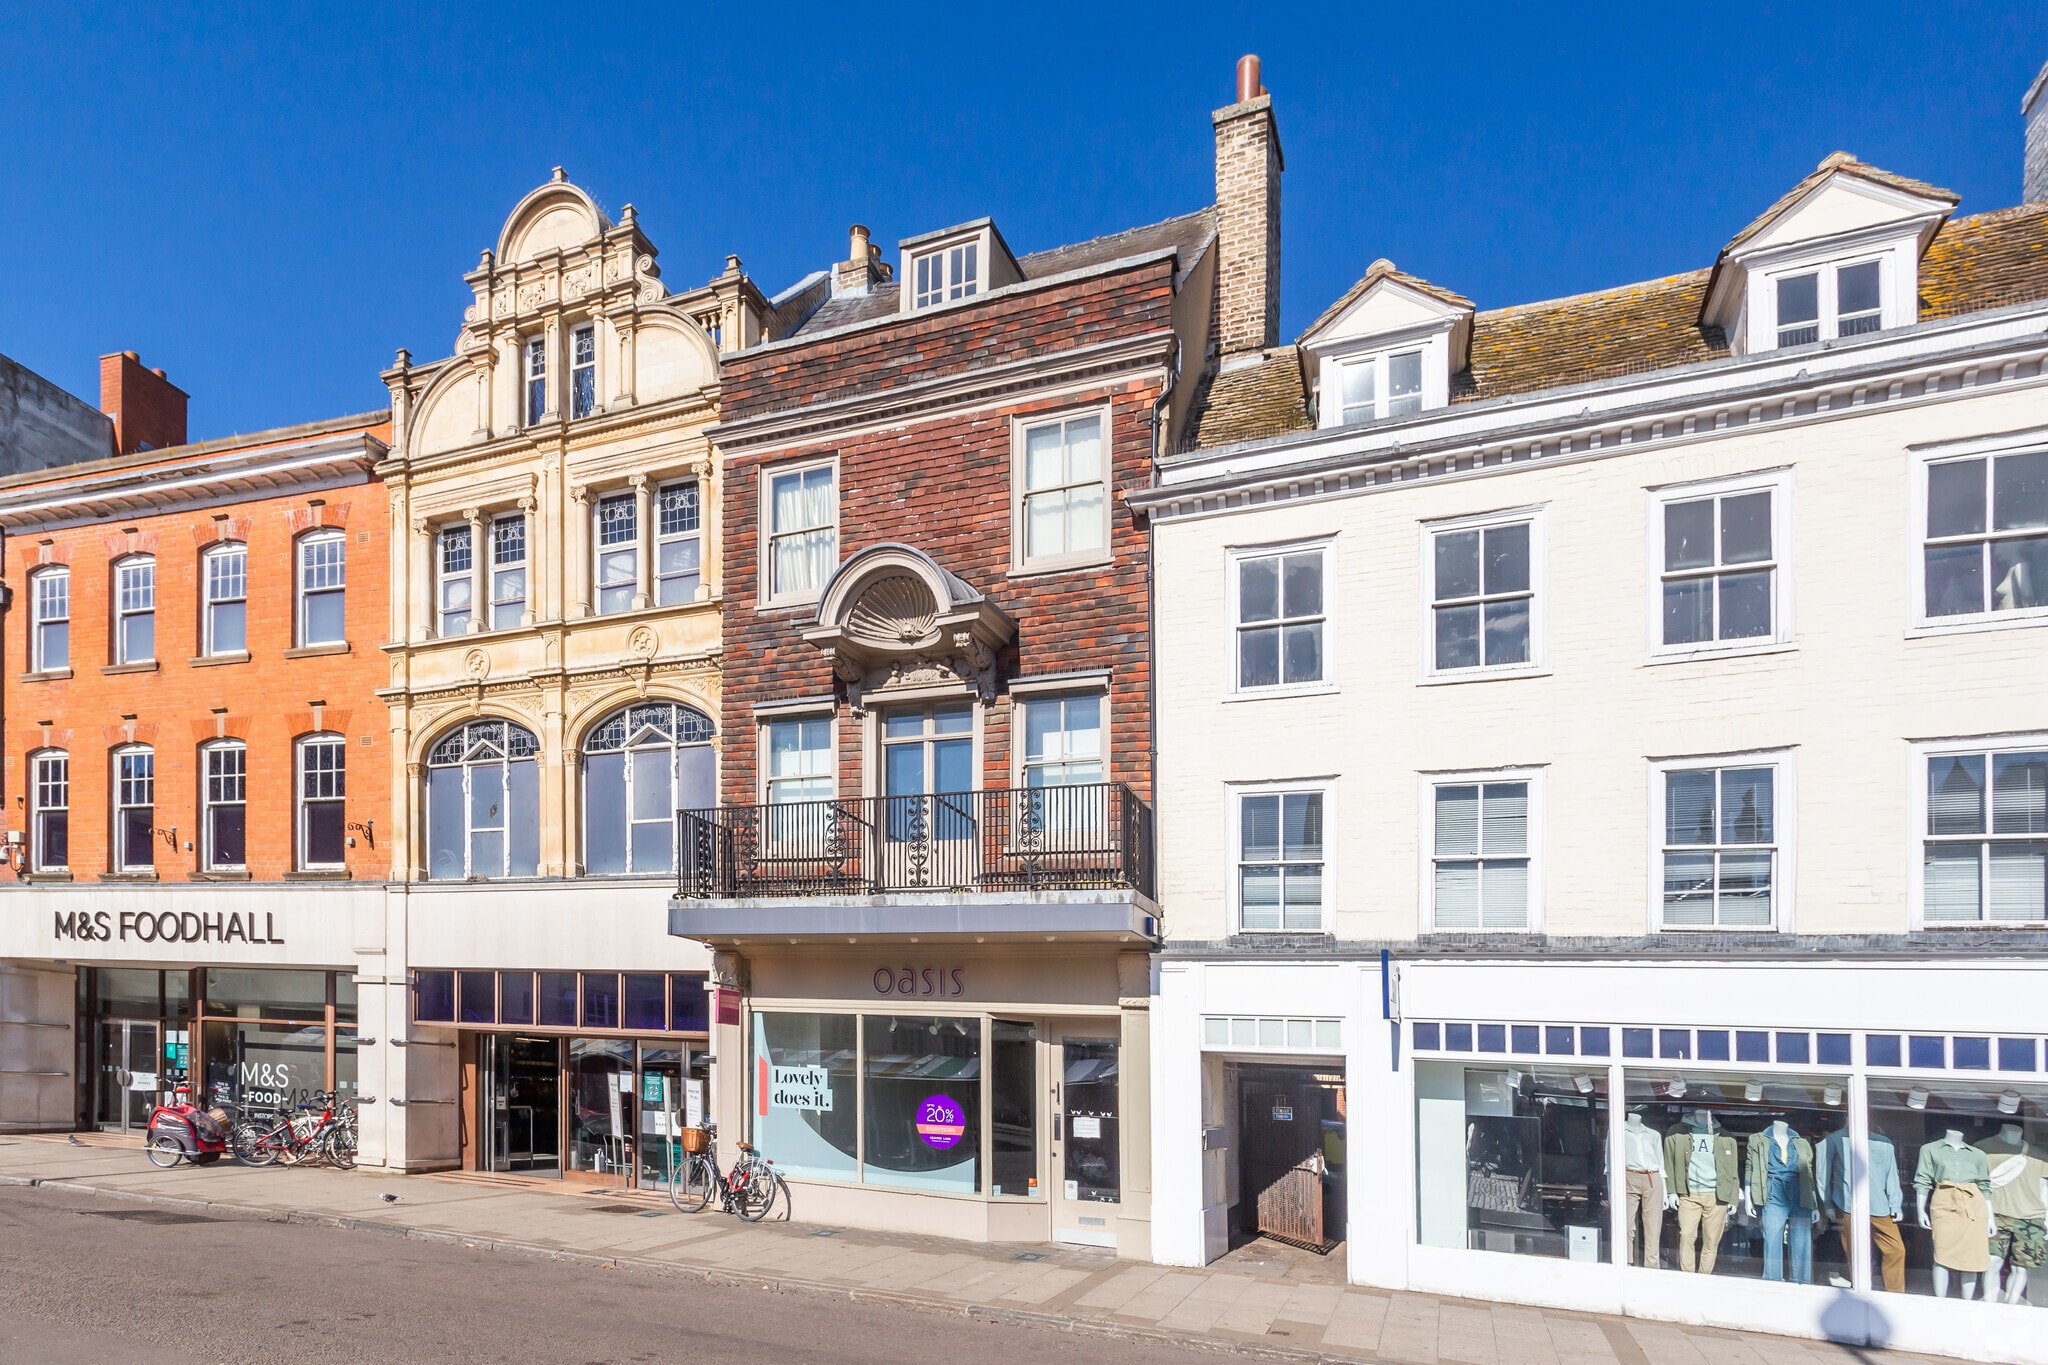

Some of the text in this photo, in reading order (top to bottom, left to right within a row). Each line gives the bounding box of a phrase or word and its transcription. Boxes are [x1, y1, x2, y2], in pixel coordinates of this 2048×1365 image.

[54, 911, 285, 944] M&S FOODHALL
[241, 1061, 289, 1088] M&S
[775, 1069, 823, 1090] Lovely
[774, 1089, 830, 1107] does it.
[926, 1107, 954, 1123] 20%
